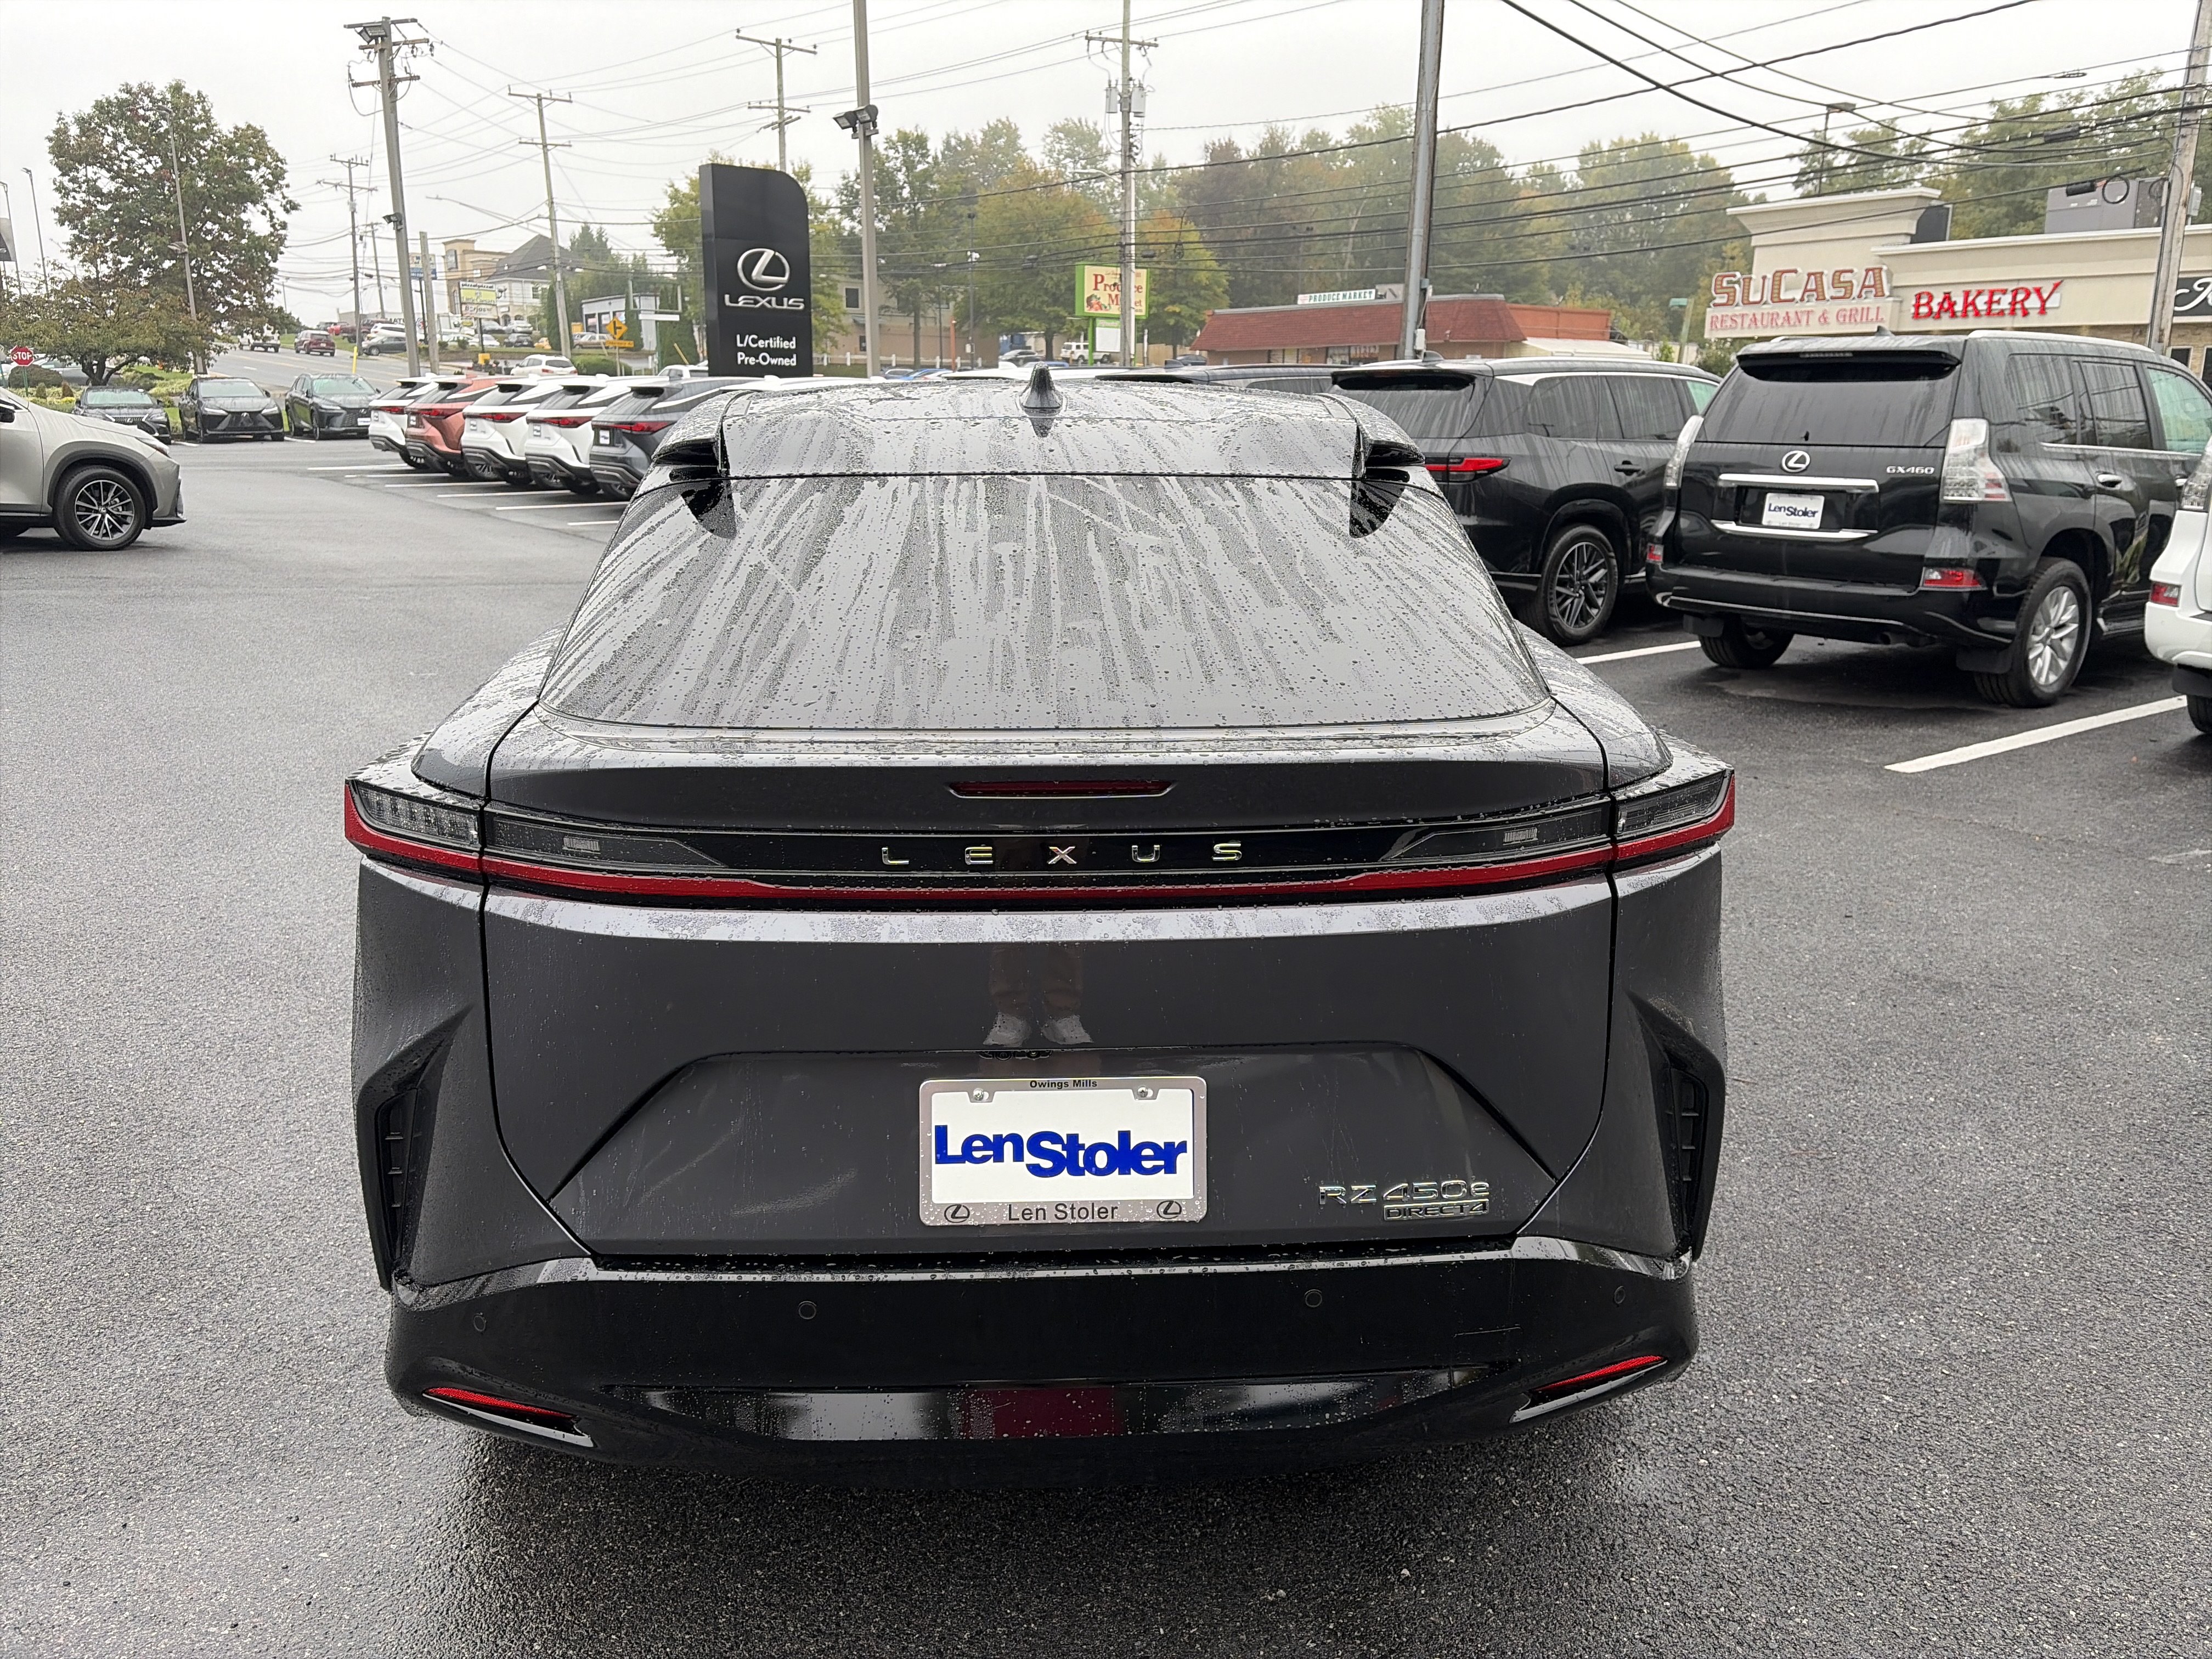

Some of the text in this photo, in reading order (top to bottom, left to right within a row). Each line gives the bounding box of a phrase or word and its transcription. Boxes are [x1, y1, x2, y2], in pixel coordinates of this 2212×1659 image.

[724, 294, 805, 310] LEXUS
[1308, 292, 1340, 302] PRODUCE
[1342, 291, 1373, 300] MARKET
[1912, 279, 2064, 320] BAKERY
[1709, 306, 1884, 330] RESTAURANT & GRILL
[736, 334, 796, 349] L/Certified
[13, 351, 32, 360] STOP
[737, 352, 797, 366] Pre-Owned
[1886, 466, 1935, 475] GX460
[881, 843, 1243, 865] LEXUS
[1029, 1079, 1098, 1089] Owings Mills
[1319, 1184, 1377, 1205] RZ
[1008, 1203, 1119, 1221] Len Stoler
[1385, 1201, 1489, 1220] DIRECT4
